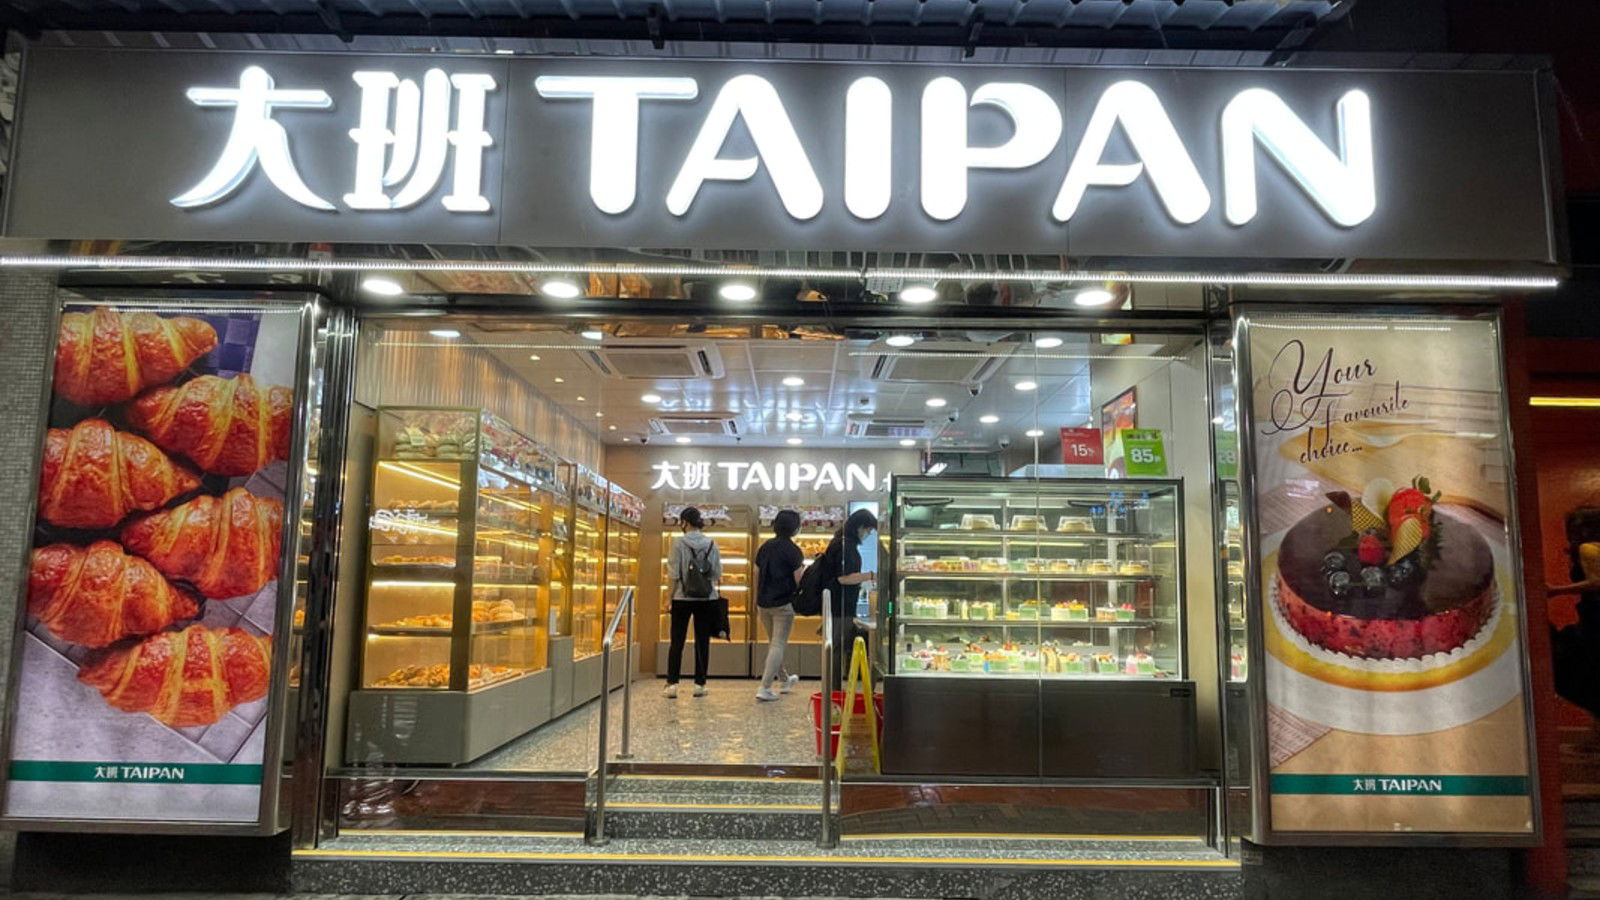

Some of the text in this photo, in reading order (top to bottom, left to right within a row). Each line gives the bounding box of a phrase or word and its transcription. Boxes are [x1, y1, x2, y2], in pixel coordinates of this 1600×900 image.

[171, 66, 1377, 228] 大班 TAIPAN
[1261, 339, 1377, 435] Your
[651, 460, 876, 492] 大班 TAIPAN
[121, 766, 185, 779] TAIPAN
[1378, 778, 1442, 791] TAIPAN
